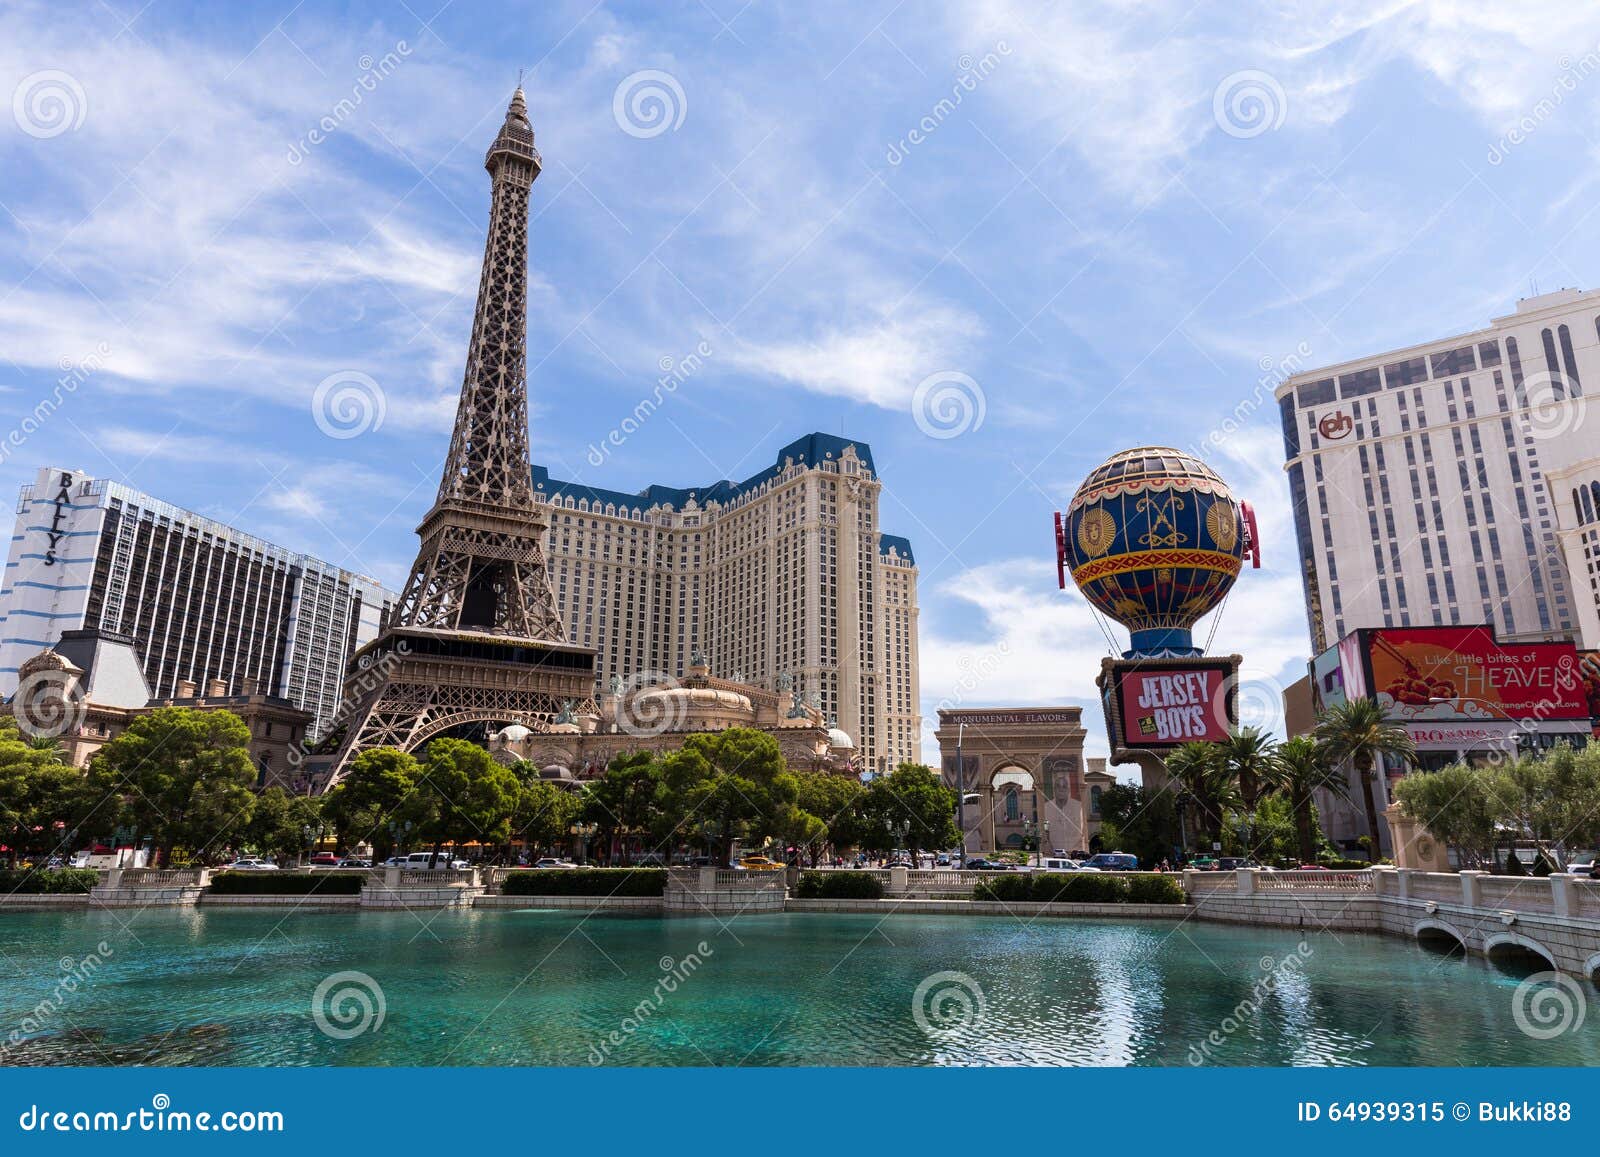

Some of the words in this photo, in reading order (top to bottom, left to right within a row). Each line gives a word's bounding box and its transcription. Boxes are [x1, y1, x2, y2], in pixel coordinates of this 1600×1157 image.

[1425, 655, 1451, 665] Like
[1456, 654, 1483, 664] little
[1487, 653, 1519, 664] bites
[1523, 652, 1537, 663] of
[1138, 671, 1209, 709] JERSEY
[1453, 665, 1571, 694] HEAVEN
[953, 714, 1020, 724] MONUMENTAL
[1154, 704, 1207, 740] BOYS
